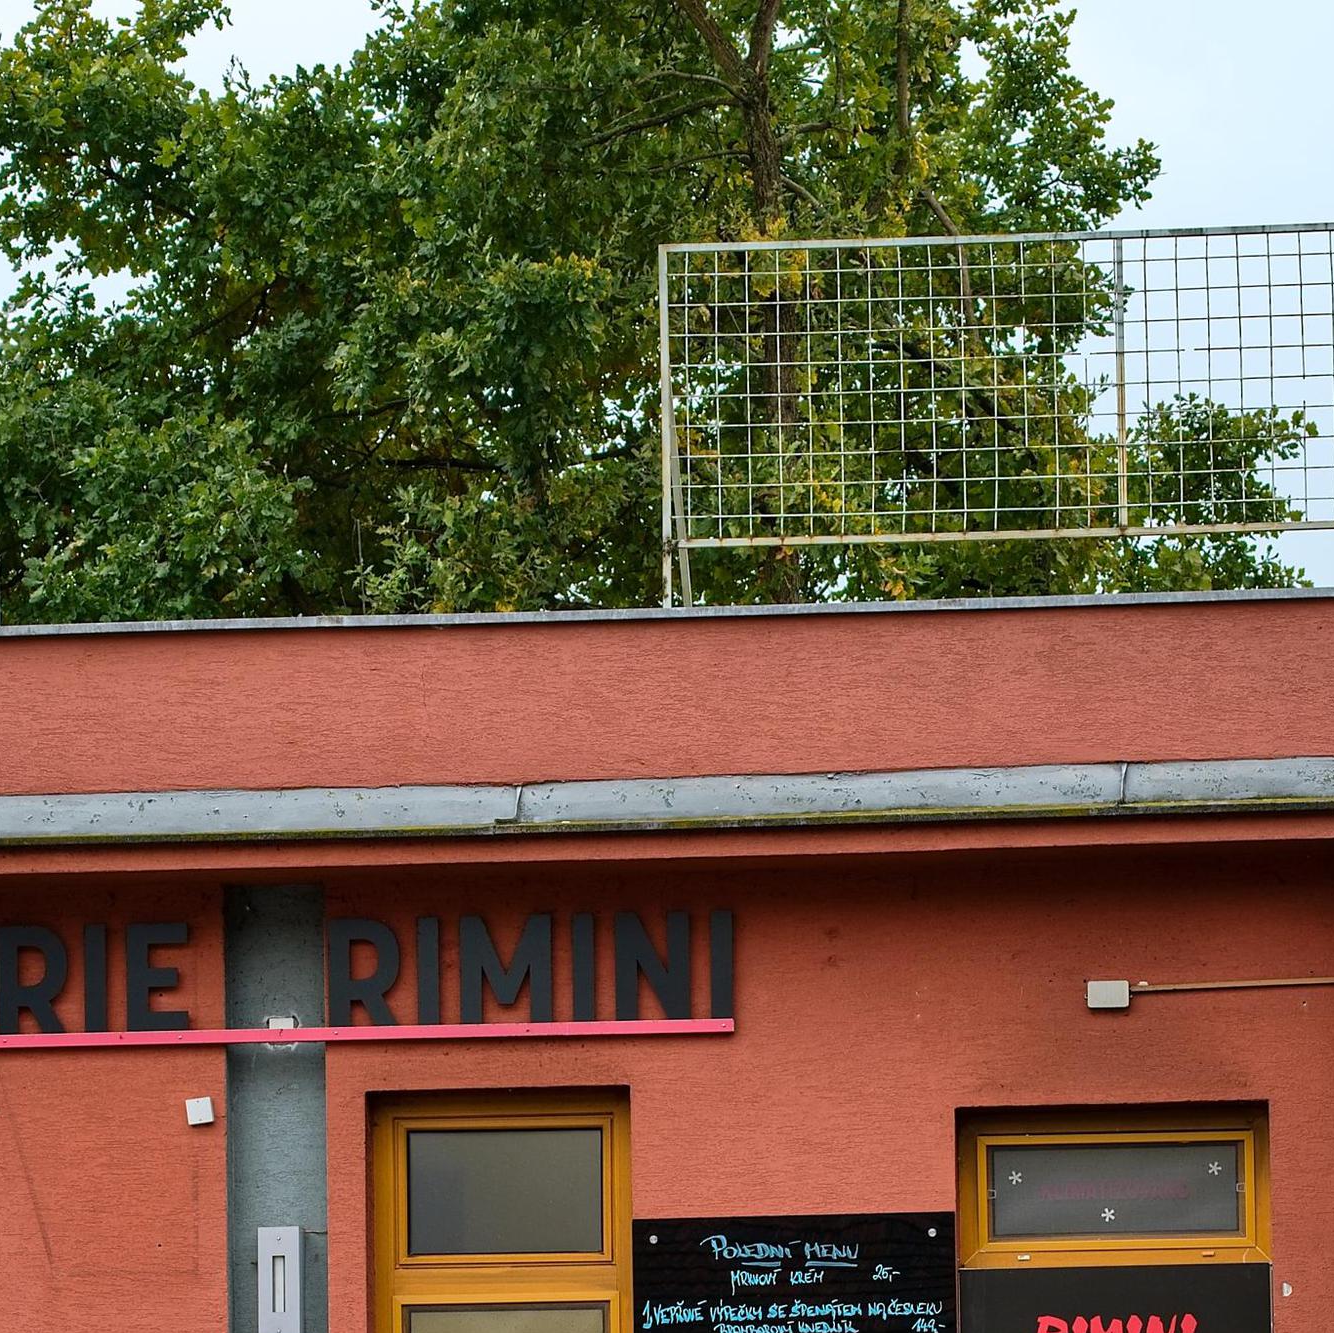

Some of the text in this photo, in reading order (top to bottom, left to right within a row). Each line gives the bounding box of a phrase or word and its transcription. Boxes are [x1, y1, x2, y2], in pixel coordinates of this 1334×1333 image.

[327, 910, 733, 1026] RIMINI
[790, 1269, 824, 1285] KRÉM
[710, 1299, 762, 1322] VÝPEČKY
[767, 1303, 788, 1319] SE
